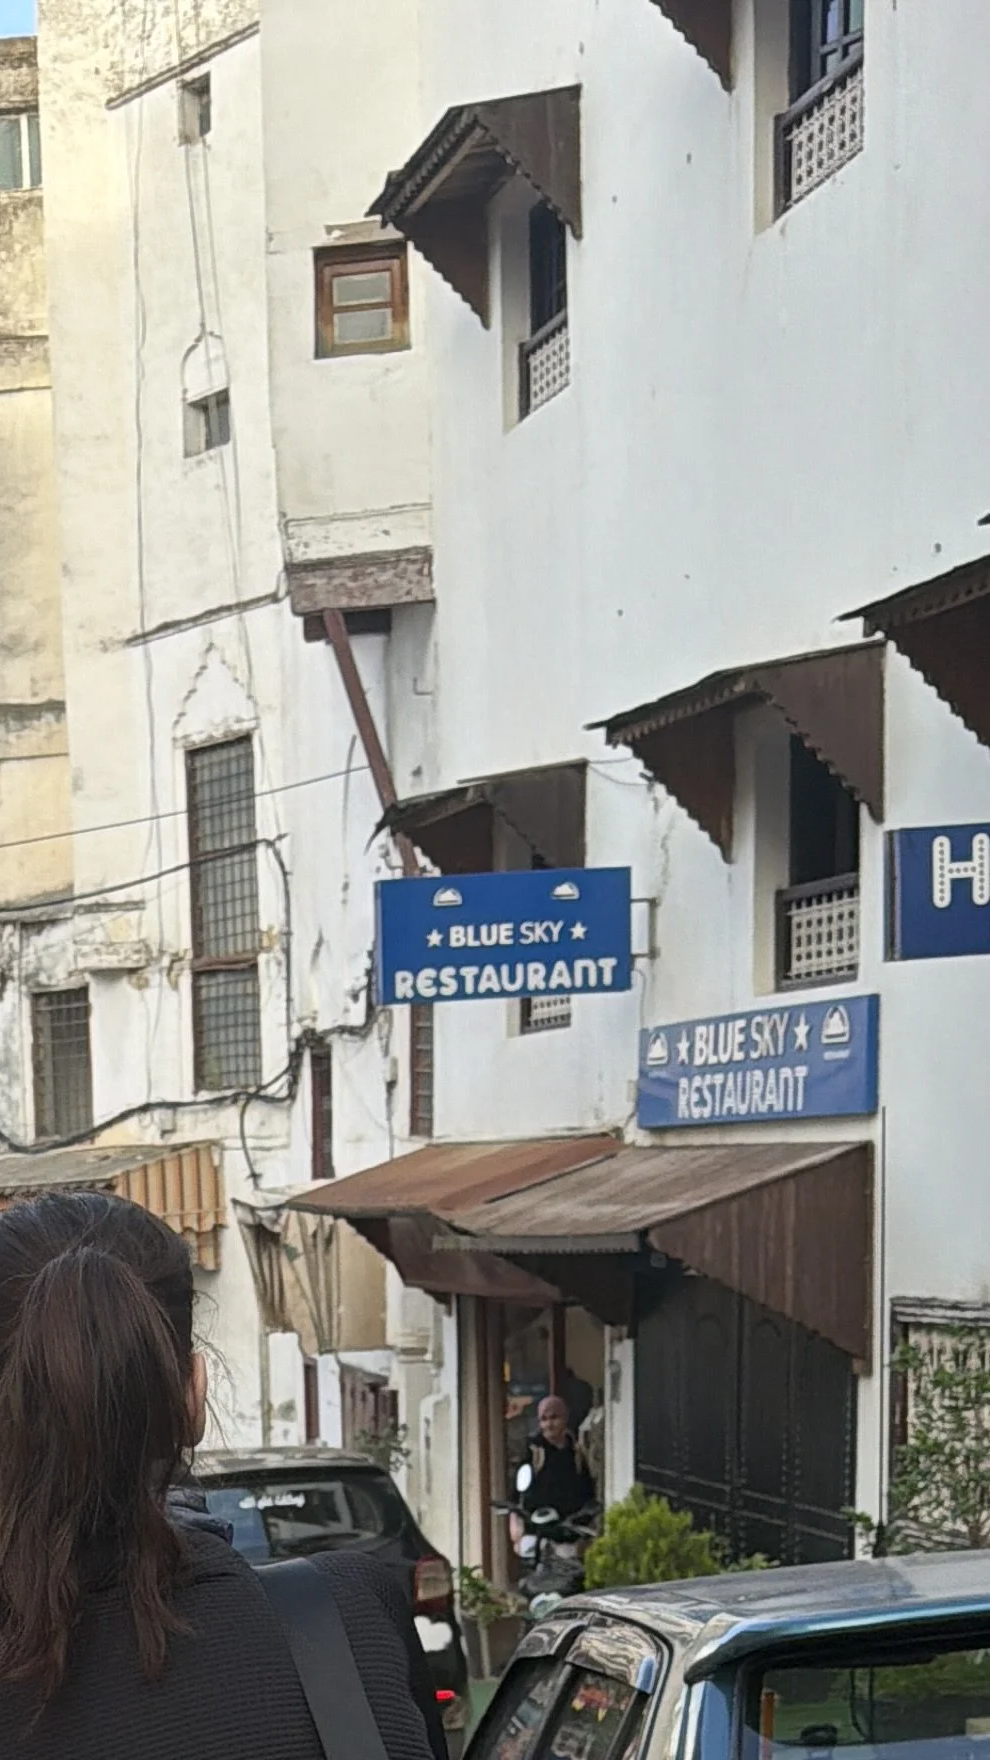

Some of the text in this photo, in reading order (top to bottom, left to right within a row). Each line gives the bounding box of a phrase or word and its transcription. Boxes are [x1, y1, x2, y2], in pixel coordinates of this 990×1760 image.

[448, 920, 564, 948] BLUE SKY
[394, 958, 618, 999] RESTAURANT
[692, 1011, 789, 1067] BLUE SKY
[677, 1065, 808, 1118] RESTAURANT
